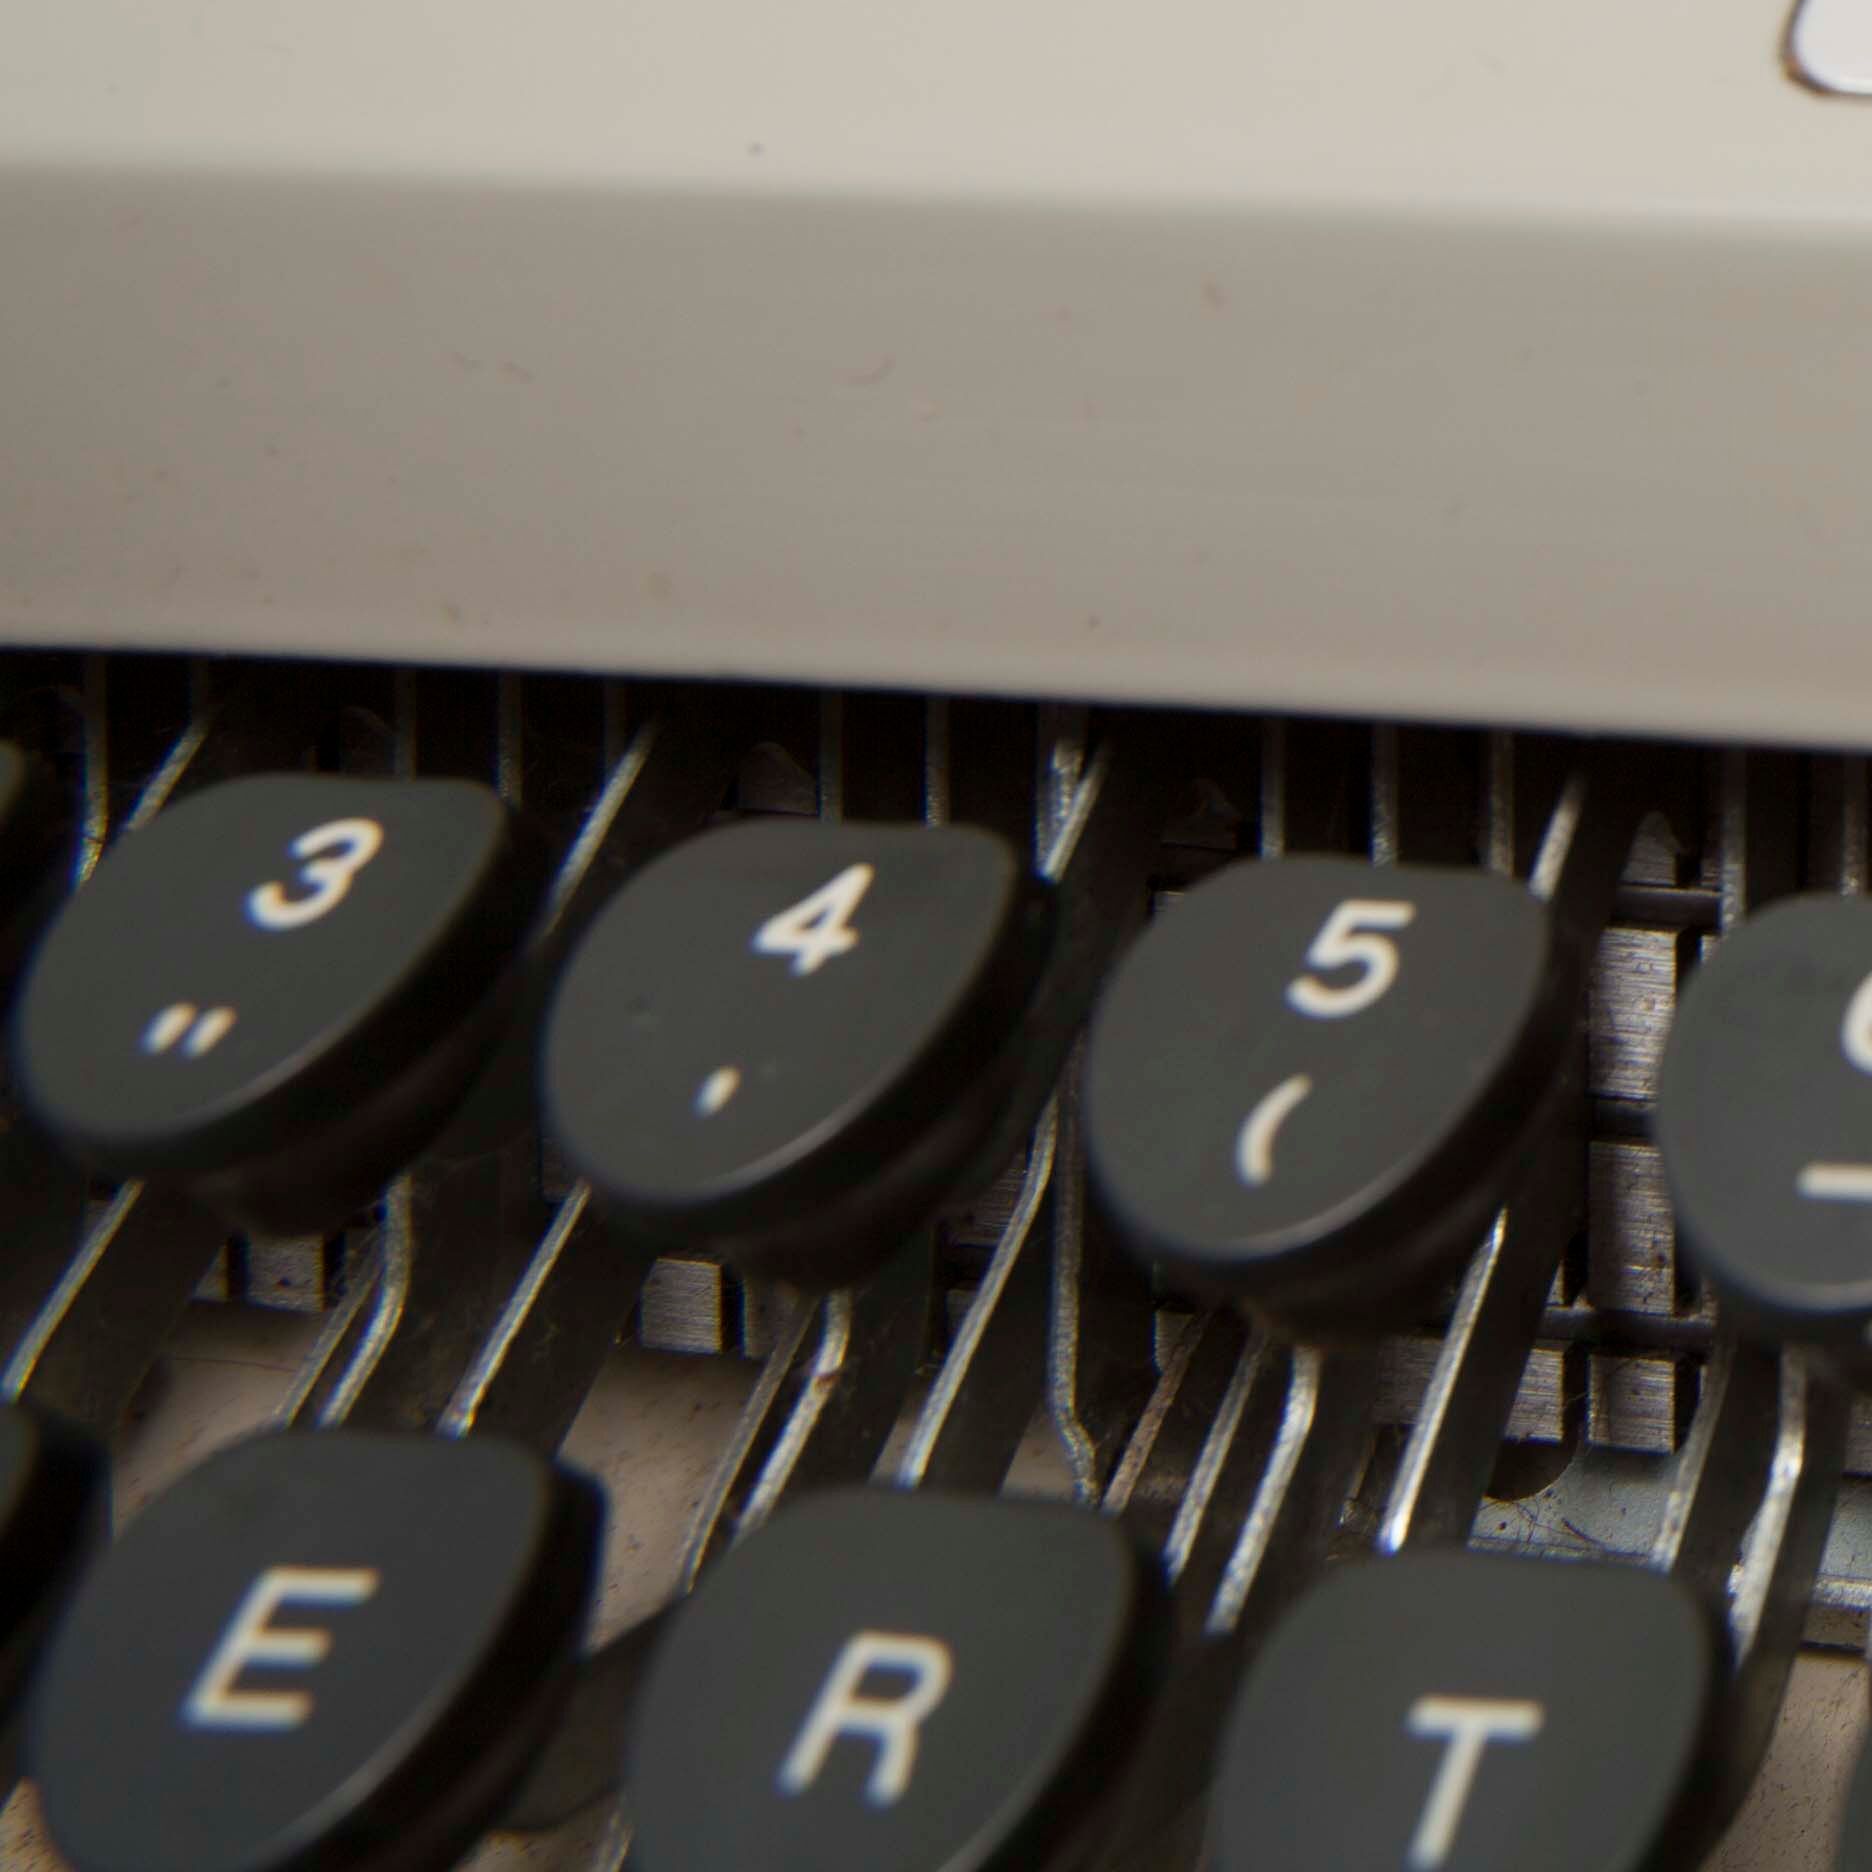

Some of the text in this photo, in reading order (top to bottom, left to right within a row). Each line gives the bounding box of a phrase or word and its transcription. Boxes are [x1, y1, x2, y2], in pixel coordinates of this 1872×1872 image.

[247, 816, 385, 931] 3
[753, 862, 874, 976] 4
[1286, 897, 1415, 1019] 5
[186, 1565, 378, 1729] E
[782, 1629, 953, 1803] R
[1408, 1694, 1543, 1869] T
